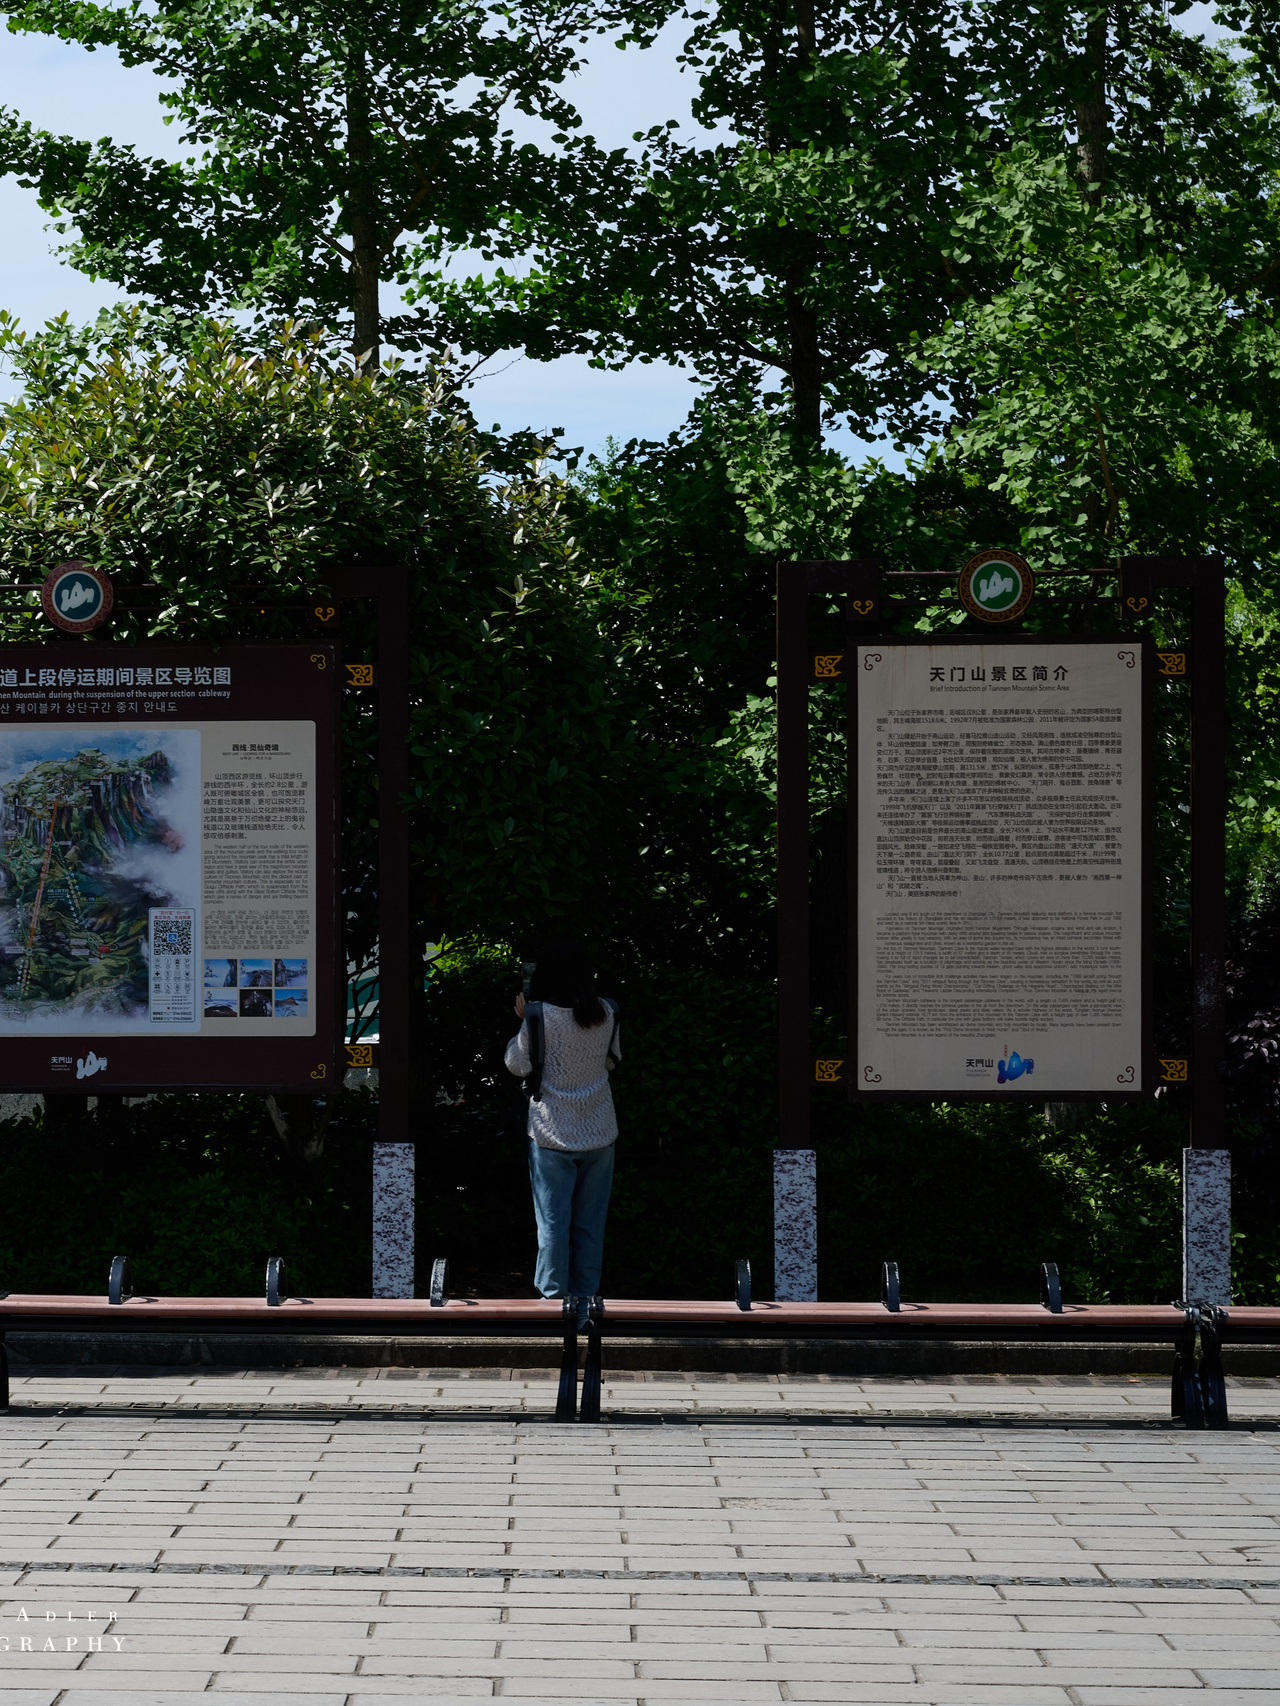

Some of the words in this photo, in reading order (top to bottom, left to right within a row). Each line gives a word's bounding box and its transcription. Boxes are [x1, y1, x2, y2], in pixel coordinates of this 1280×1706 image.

[930, 665, 1068, 682] 天门山景区简介
[49, 691, 72, 700] during
[198, 690, 230, 698] cableway
[15, 702, 61, 714] 케이블카
[66, 702, 111, 713] 상단구간
[116, 701, 138, 713] 중지
[144, 701, 178, 712] 안내도
[966, 1059, 993, 1067] 天門山
